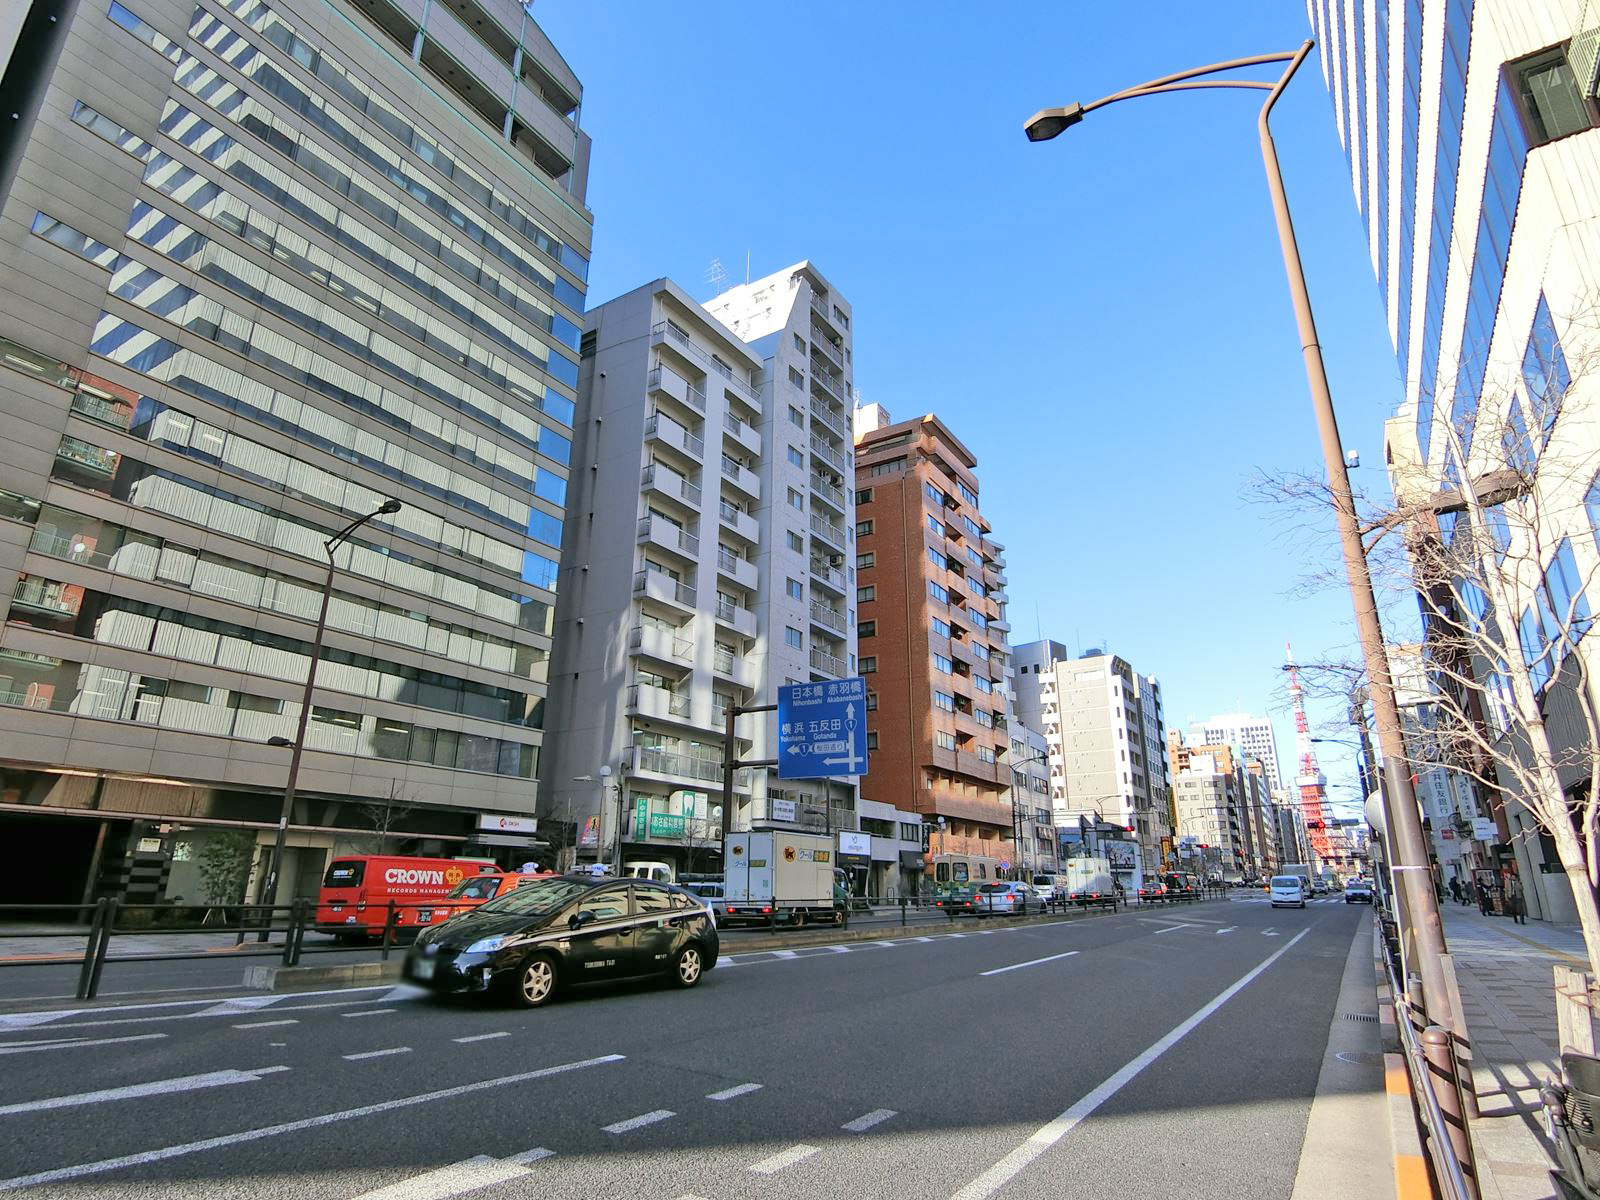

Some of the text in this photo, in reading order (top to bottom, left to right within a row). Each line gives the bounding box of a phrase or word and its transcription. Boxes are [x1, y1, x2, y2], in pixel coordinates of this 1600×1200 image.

[792, 681, 862, 699] 日本橋 赤羽橋
[792, 693, 864, 707] Nihonbashi Akabanebashi
[781, 718, 841, 735] 横浜 五反田
[780, 732, 838, 743] Yokohama Gotanda
[816, 743, 844, 752] 桜田通り
[385, 868, 444, 885] CROWN
[386, 887, 418, 895] RECORDS
